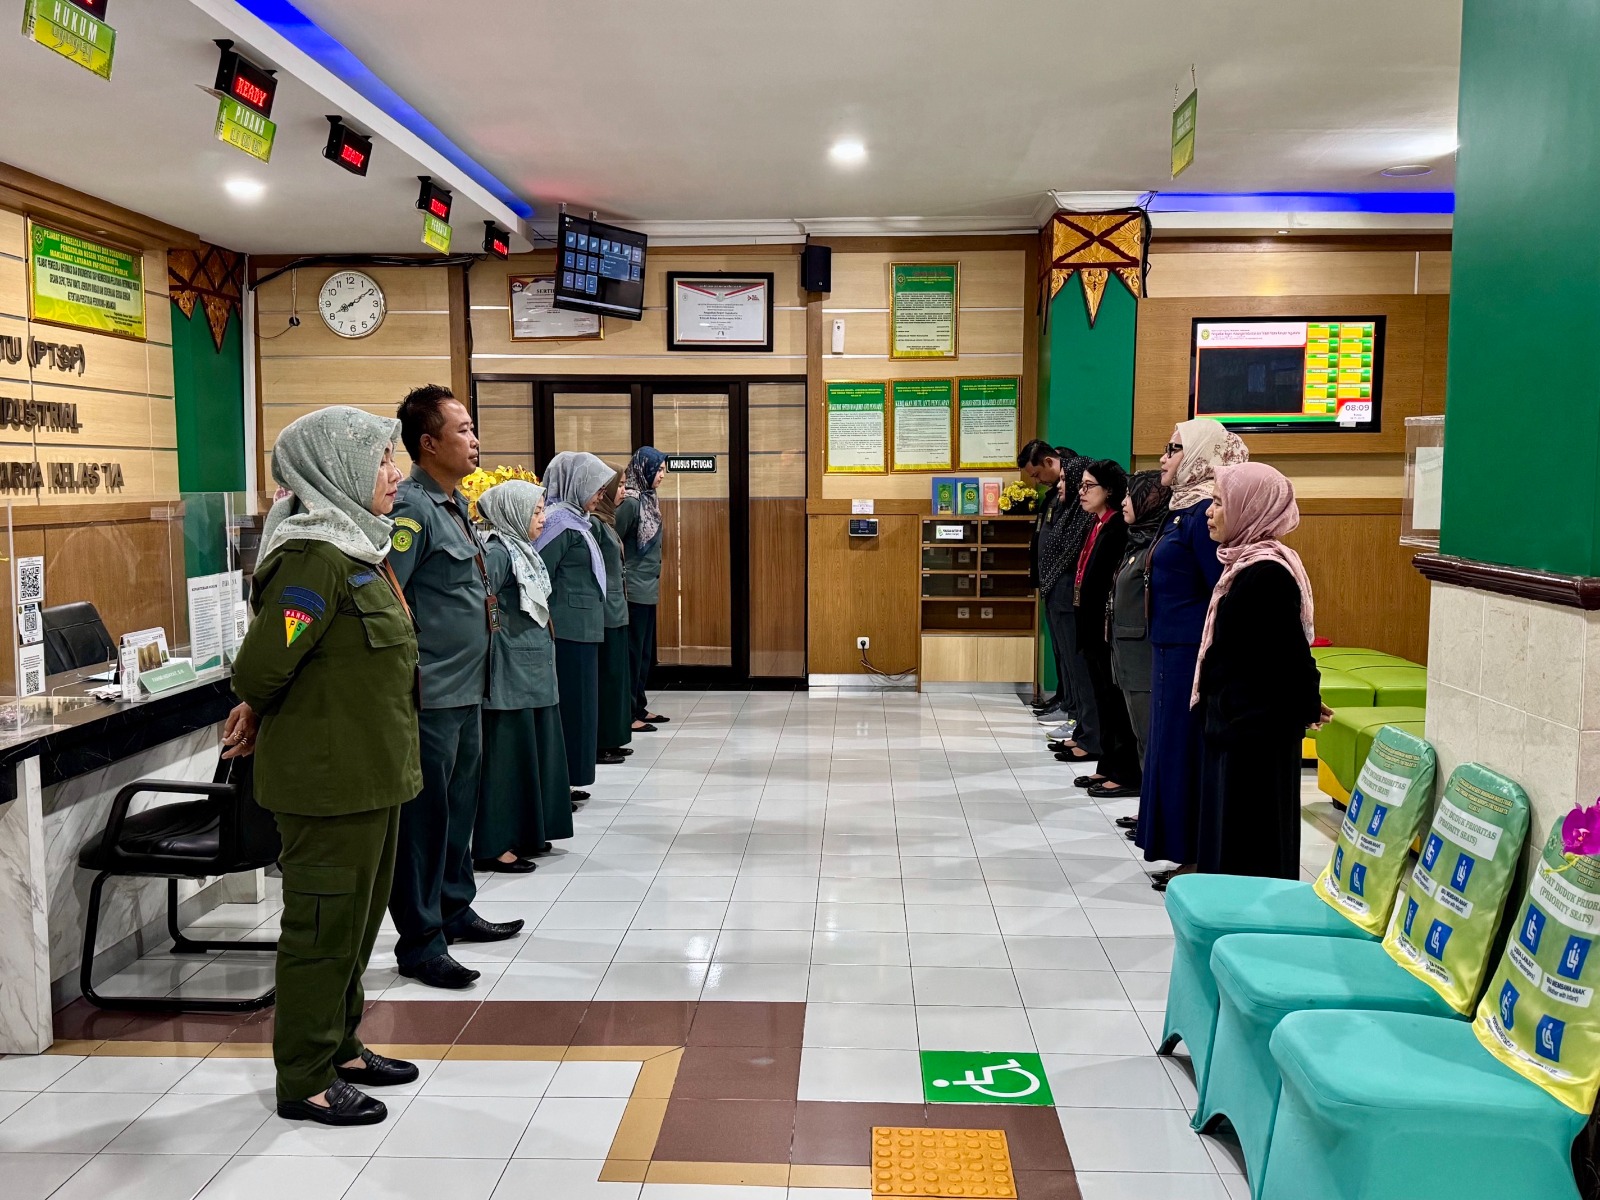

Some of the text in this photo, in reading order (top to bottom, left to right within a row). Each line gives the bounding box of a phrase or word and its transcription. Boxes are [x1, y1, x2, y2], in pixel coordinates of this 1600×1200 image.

[54, 1, 97, 43] HUKUM
[236, 77, 268, 107] READY
[235, 105, 265, 136] PIDANA
[346, 276, 355, 285] 12
[328, 288, 337, 296] 10
[368, 288, 375, 296] 2
[325, 300, 331, 308] 9
[372, 300, 379, 308] 3
[329, 312, 336, 320] 8
[369, 312, 376, 320] 4
[338, 321, 344, 329] 7
[361, 321, 368, 329] 5
[670, 460, 713, 469] KHUSUS PETUGAS
[47, 462, 100, 490] KELAS
[297, 622, 302, 631] S
[1464, 820, 1497, 840] PRIORITAS
[1555, 883, 1576, 903] DUDUK
[1540, 885, 1594, 925] (PRIORITY SEATS)
